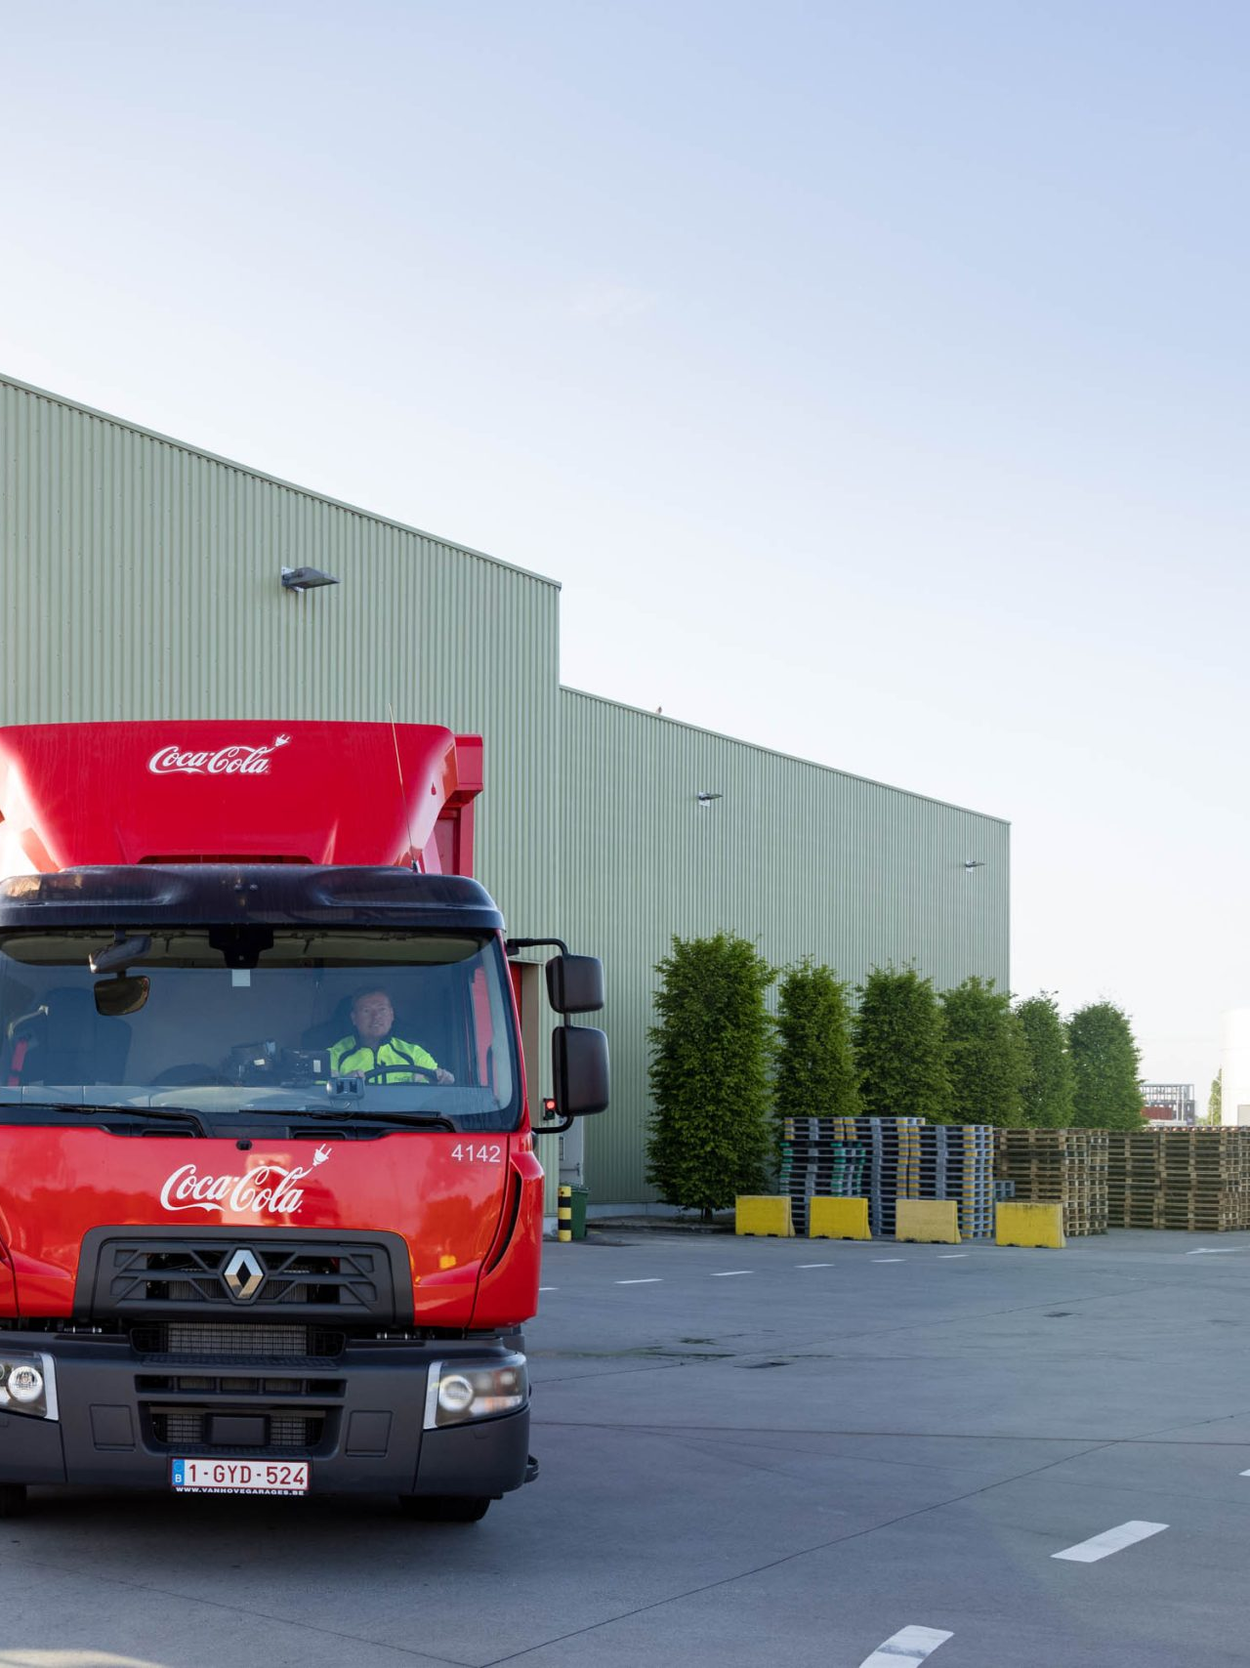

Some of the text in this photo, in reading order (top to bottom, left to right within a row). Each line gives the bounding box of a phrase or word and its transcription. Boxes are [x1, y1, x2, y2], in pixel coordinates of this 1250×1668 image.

[149, 746, 275, 773] Coca-Cola
[451, 1144, 501, 1163] 4142
[160, 1164, 312, 1213] Coca-Cola
[175, 1464, 305, 1485] B 1-GYD-524
[176, 1486, 305, 1496] WWW.VANHOVEGARAGES.BE
